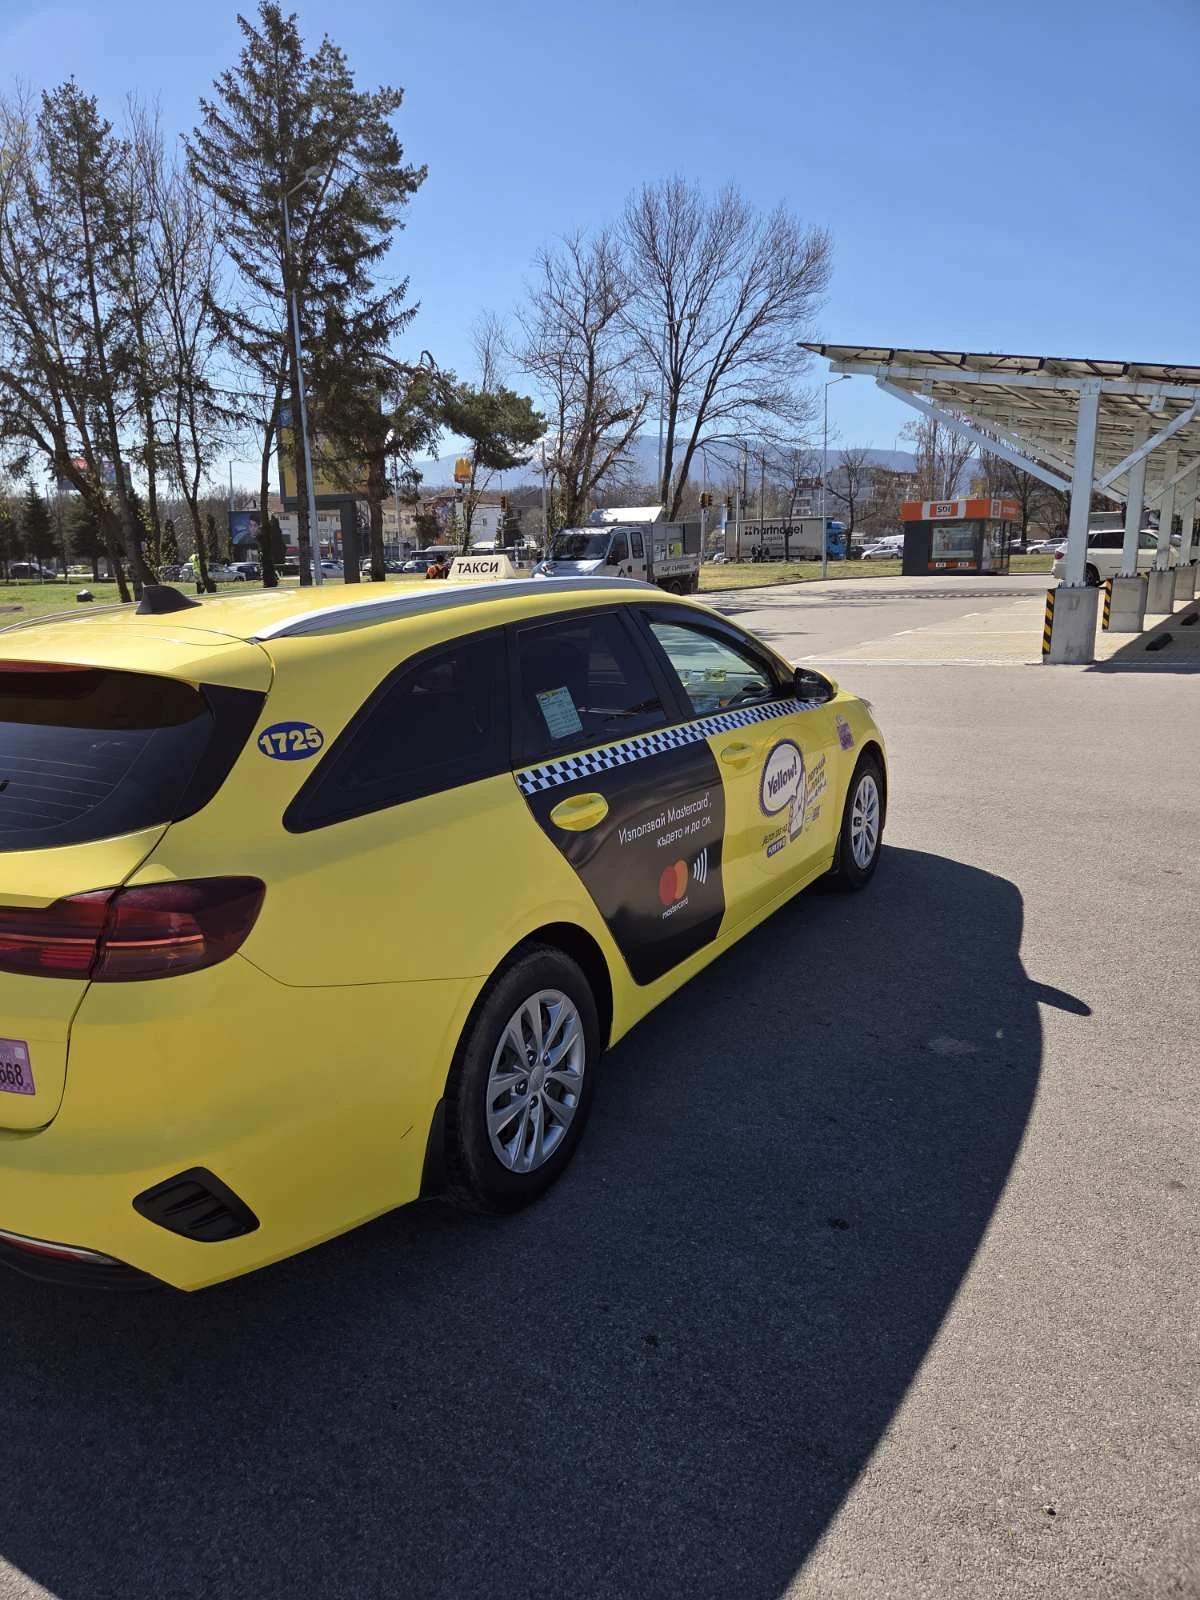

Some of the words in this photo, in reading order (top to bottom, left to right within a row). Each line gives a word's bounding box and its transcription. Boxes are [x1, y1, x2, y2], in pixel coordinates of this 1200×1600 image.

[456, 562, 499, 574] ТАКСИ
[260, 727, 322, 755] 1725
[767, 755, 798, 798] Yellow!
[618, 812, 666, 845] Използвай
[657, 828, 683, 848] където
[684, 825, 690, 835] и
[690, 821, 700, 834] до
[662, 897, 689, 920] mastercard
